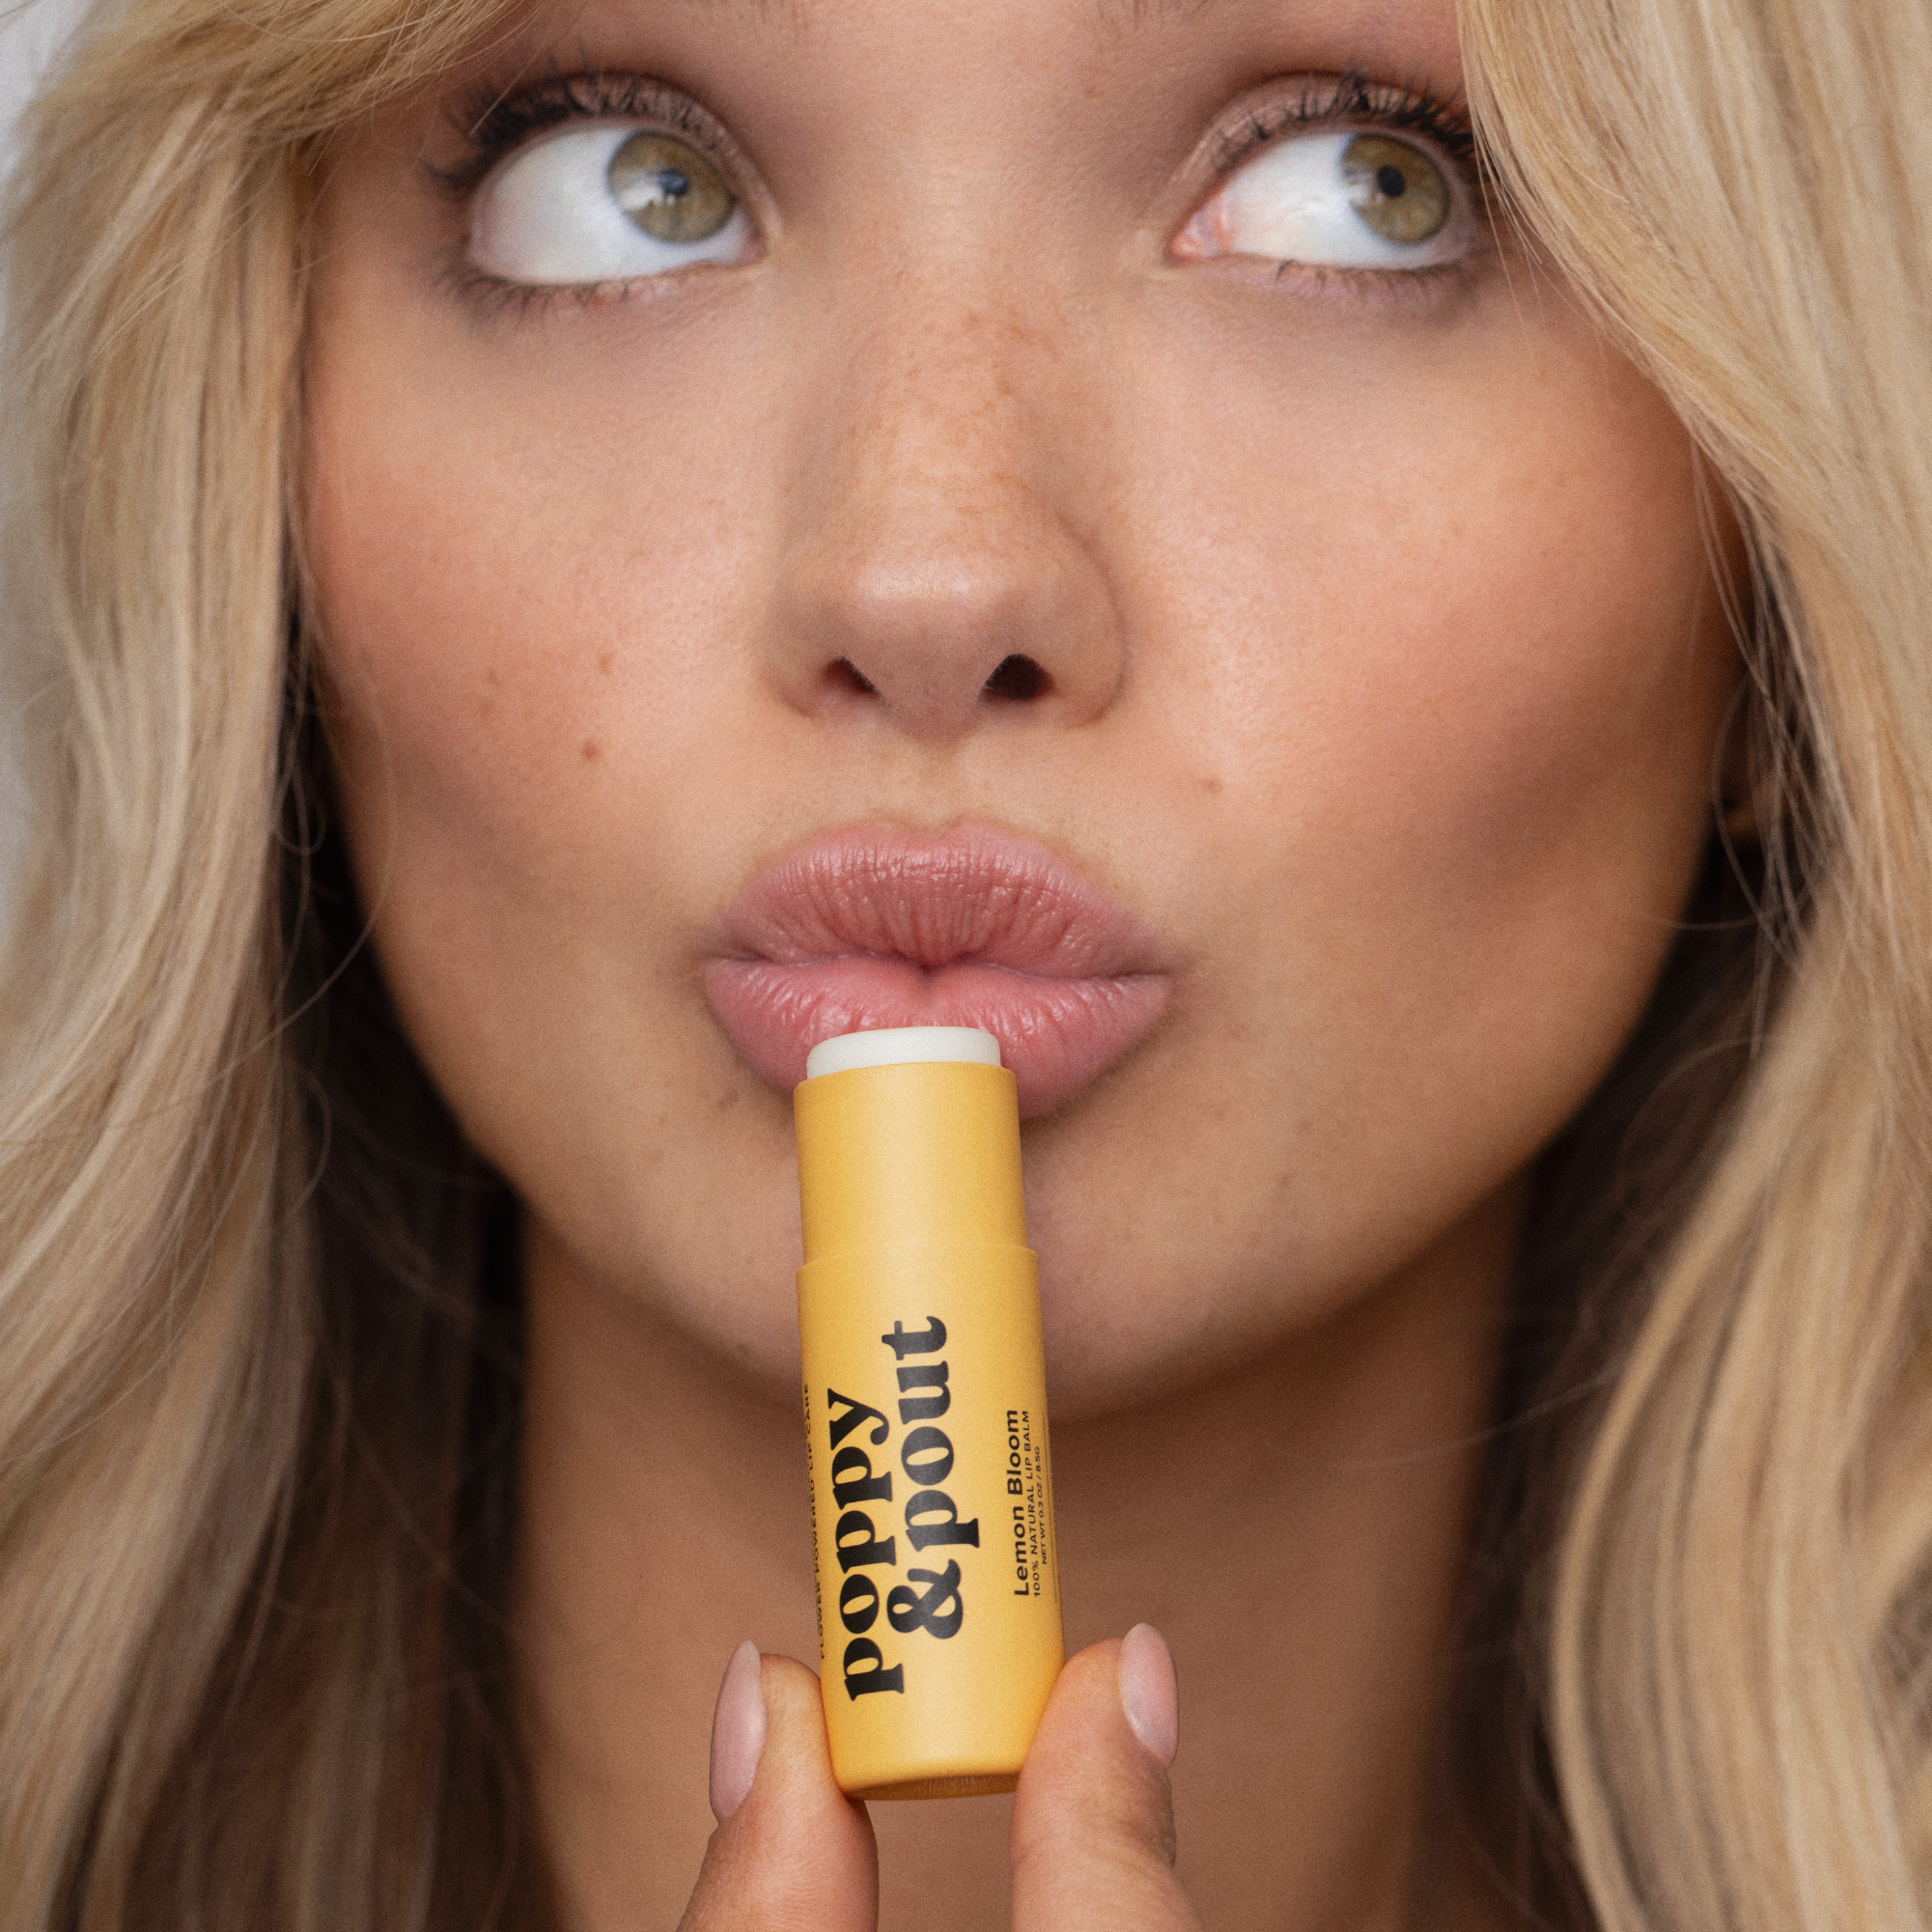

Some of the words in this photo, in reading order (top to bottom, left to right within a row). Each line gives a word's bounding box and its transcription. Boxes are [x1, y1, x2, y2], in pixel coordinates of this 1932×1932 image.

[881, 1316, 979, 1552] pout
[1007, 1410, 1023, 1496] Bloom
[1022, 1410, 1031, 1452] BALM
[1024, 1457, 1033, 1480] LIP
[827, 1387, 904, 1701] poppy
[1012, 1506, 1029, 1596] Lemon
[1026, 1485, 1038, 1555] NATURAL
[1039, 1520, 1046, 1540] WT
[887, 1558, 964, 1639] &
[1031, 1560, 1041, 1597] 100%
